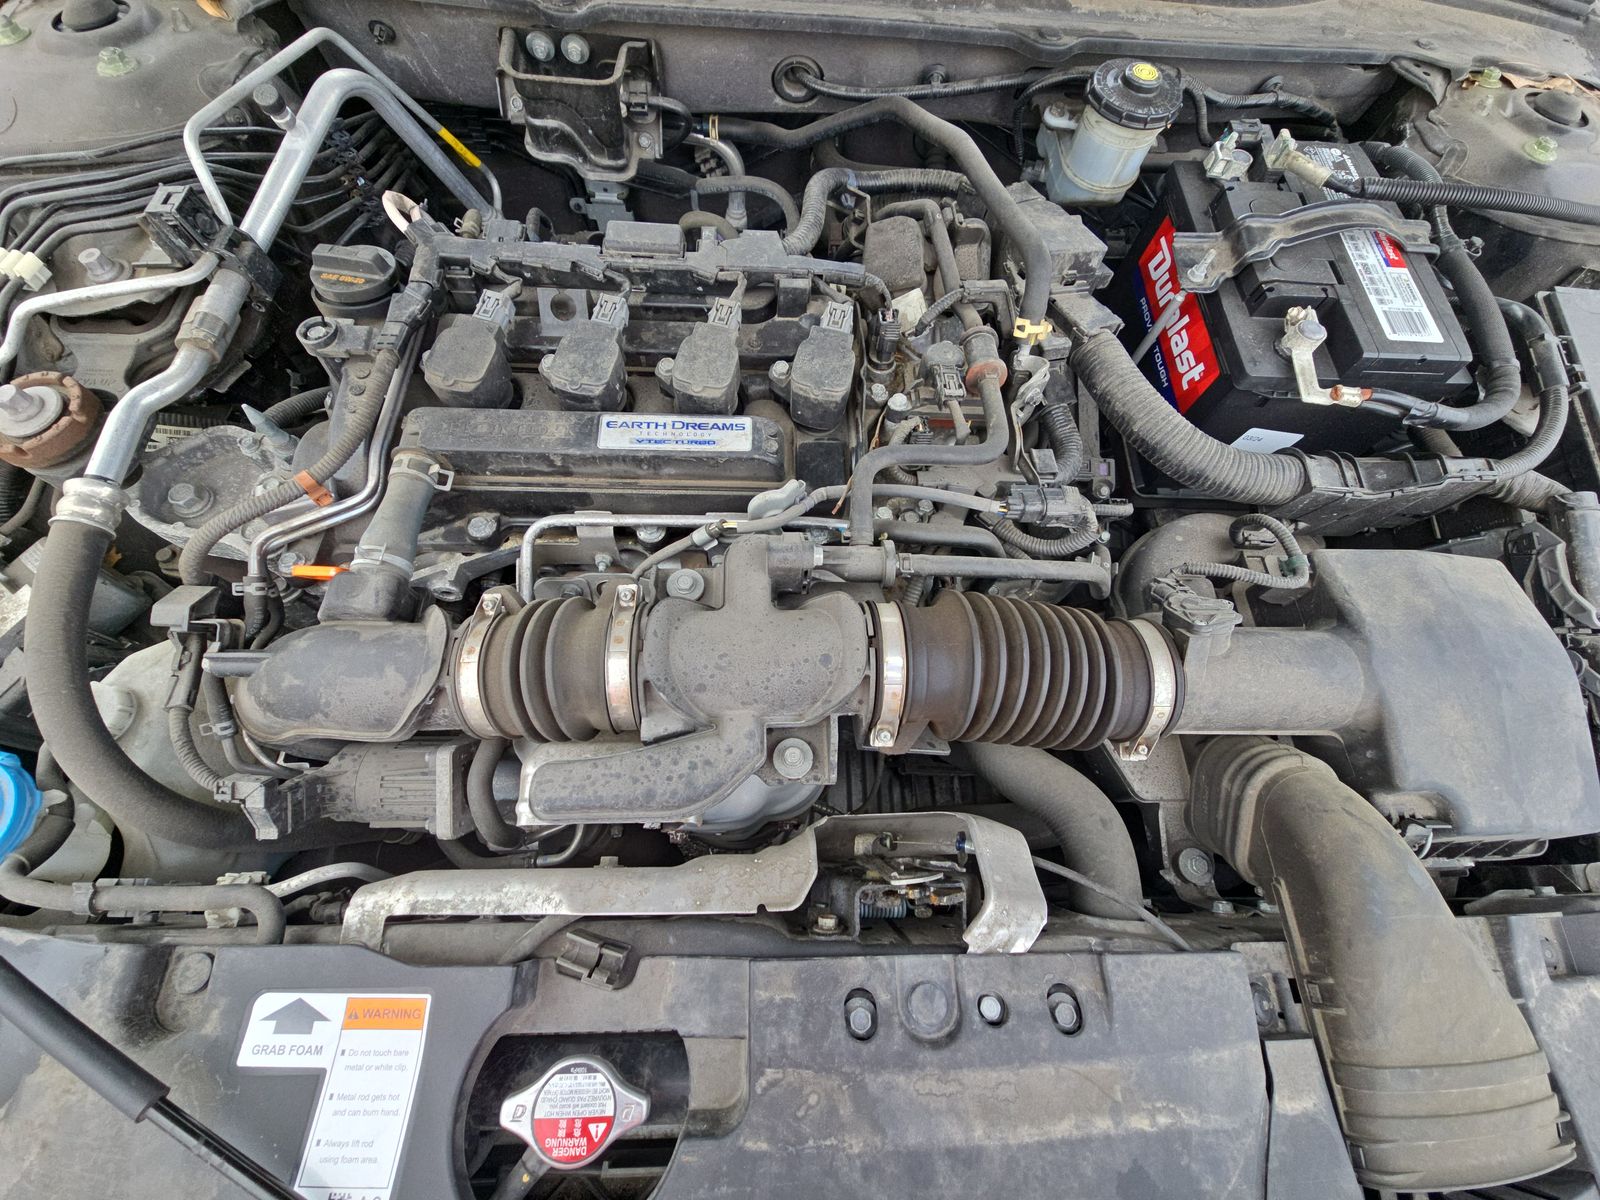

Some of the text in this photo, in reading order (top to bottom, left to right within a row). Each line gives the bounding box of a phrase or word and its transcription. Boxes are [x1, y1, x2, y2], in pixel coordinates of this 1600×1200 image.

[1139, 297, 1169, 388] PROV TOUGH
[606, 420, 746, 431] EARTH DREAMS
[674, 438, 717, 446] TURBO
[362, 1008, 422, 1020] WARNING
[251, 1044, 324, 1056] GRAB FOAM
[348, 1048, 410, 1057] Do not touch bare
[344, 1063, 365, 1072] metal
[374, 1063, 394, 1072] white
[337, 1092, 401, 1103] Metal rod gets hot
[332, 1108, 346, 1117] and
[362, 1108, 379, 1117] burn
[323, 1139, 375, 1150] Always lift rod
[545, 1137, 588, 1148] WARNUNG
[551, 1146, 588, 1157] DANGER
[319, 1156, 340, 1166] using
[340, 1155, 359, 1164] foam
